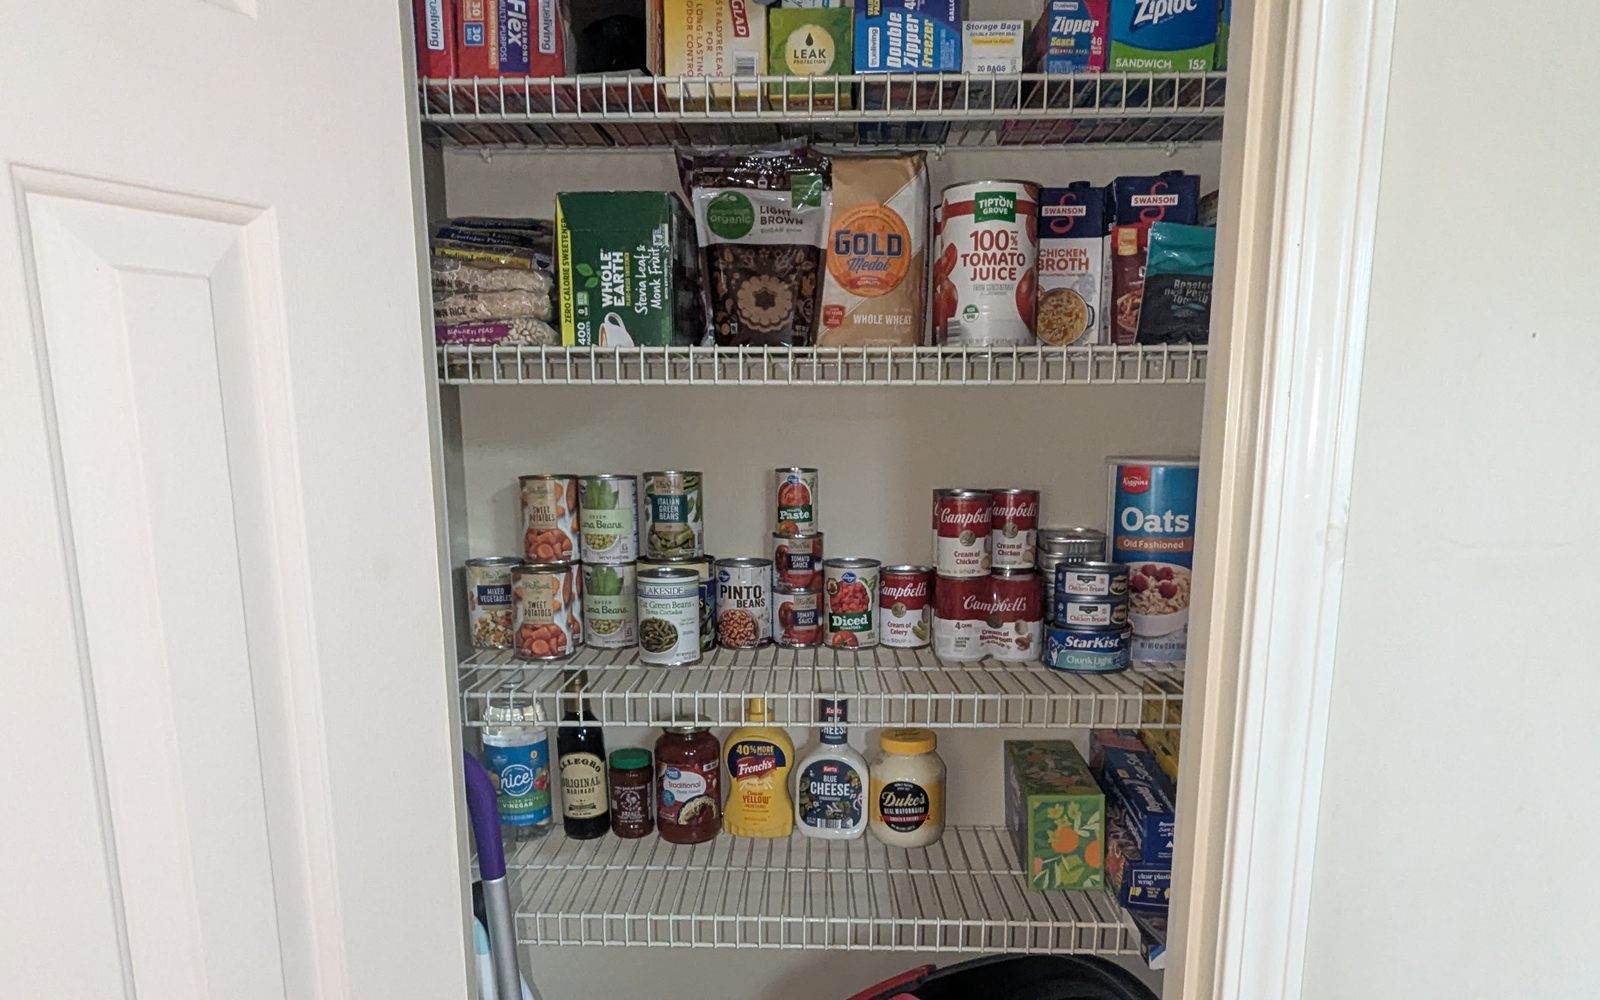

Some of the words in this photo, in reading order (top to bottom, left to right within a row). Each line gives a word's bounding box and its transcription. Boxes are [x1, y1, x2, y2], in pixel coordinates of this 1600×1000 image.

[472, 1, 481, 16] 30
[1133, 0, 1198, 25] Ziploc
[686, 1, 694, 31] ODOR
[732, 0, 748, 36] GLAD
[430, 0, 441, 48] rueliving
[507, 0, 527, 47] Flex
[541, 0, 555, 51] rueliving
[965, 23, 998, 31] Storage
[1000, 22, 1022, 31] Bags
[1051, 16, 1100, 35] Zipper
[472, 26, 481, 42] 30
[715, 0, 725, 78] STEADYRELEAS
[887, 12, 902, 68] Double
[904, 14, 921, 68] Zipper
[706, 31, 714, 52] FOR
[922, 19, 934, 68] Freezer
[1050, 37, 1075, 46] Snack
[1091, 37, 1103, 46] 40
[686, 33, 694, 78] CONTRO
[793, 48, 827, 59] LEAK
[1116, 58, 1172, 69] SANDWICH
[1188, 59, 1207, 70] 152
[978, 195, 1014, 209] TIPTON
[1134, 196, 1176, 205] SWANSON
[760, 206, 792, 216] LIGHT
[760, 216, 804, 226] BROWN
[637, 244, 646, 252] &
[835, 230, 903, 256] GOLD
[960, 252, 1026, 267] TOMATO
[1038, 248, 1087, 258] CHICKEN
[634, 255, 651, 278] Leaf
[647, 247, 663, 275] Fruit
[847, 257, 890, 273] Medal
[1037, 258, 1090, 271] BROTH
[601, 251, 613, 308] WHOLE
[612, 252, 625, 307] EARTH
[970, 267, 1017, 281] JUICE
[563, 268, 572, 300] CALORIE
[634, 281, 648, 315] Stevia
[650, 279, 663, 309] Monk
[564, 302, 573, 324] ZERO
[853, 314, 882, 325] WHOLE
[885, 315, 912, 325] WHEAT
[577, 322, 586, 345] 400
[657, 497, 680, 506] ITALIAN
[533, 505, 551, 513] SWEET
[658, 505, 679, 513] GREEN
[659, 512, 680, 520] BEANS
[780, 509, 811, 520] Paste
[992, 502, 1037, 519] ampbell's
[529, 513, 556, 521] POTATOES
[940, 507, 992, 527] Campbell
[1122, 507, 1190, 533] Oats
[596, 520, 624, 529] Beans
[1124, 539, 1137, 547] Old
[1139, 540, 1184, 549] Fashioned
[720, 585, 762, 600] PINTO
[528, 601, 546, 609] SWEET
[601, 606, 627, 614] Beans
[649, 600, 670, 609] Green
[671, 601, 692, 609] Beans
[736, 598, 766, 608] BEANS
[962, 594, 1027, 614] Campbell's
[524, 609, 552, 617] POTATOES
[797, 610, 815, 618] TOMATO
[832, 614, 868, 626] Diced
[1064, 635, 1120, 648] StarKist
[1066, 655, 1093, 664] Chunk
[1094, 655, 1112, 666] Light
[736, 744, 757, 755] 40%
[738, 759, 774, 775] French's
[501, 772, 531, 790] nice
[562, 776, 601, 788] ORIGINAL
[668, 780, 702, 789] Traditional
[823, 775, 838, 783] BLUE
[810, 782, 851, 796] CHEESE
[743, 795, 769, 805] YELLOW
[881, 791, 926, 807] Duke's
[1153, 873, 1171, 881] plasti
